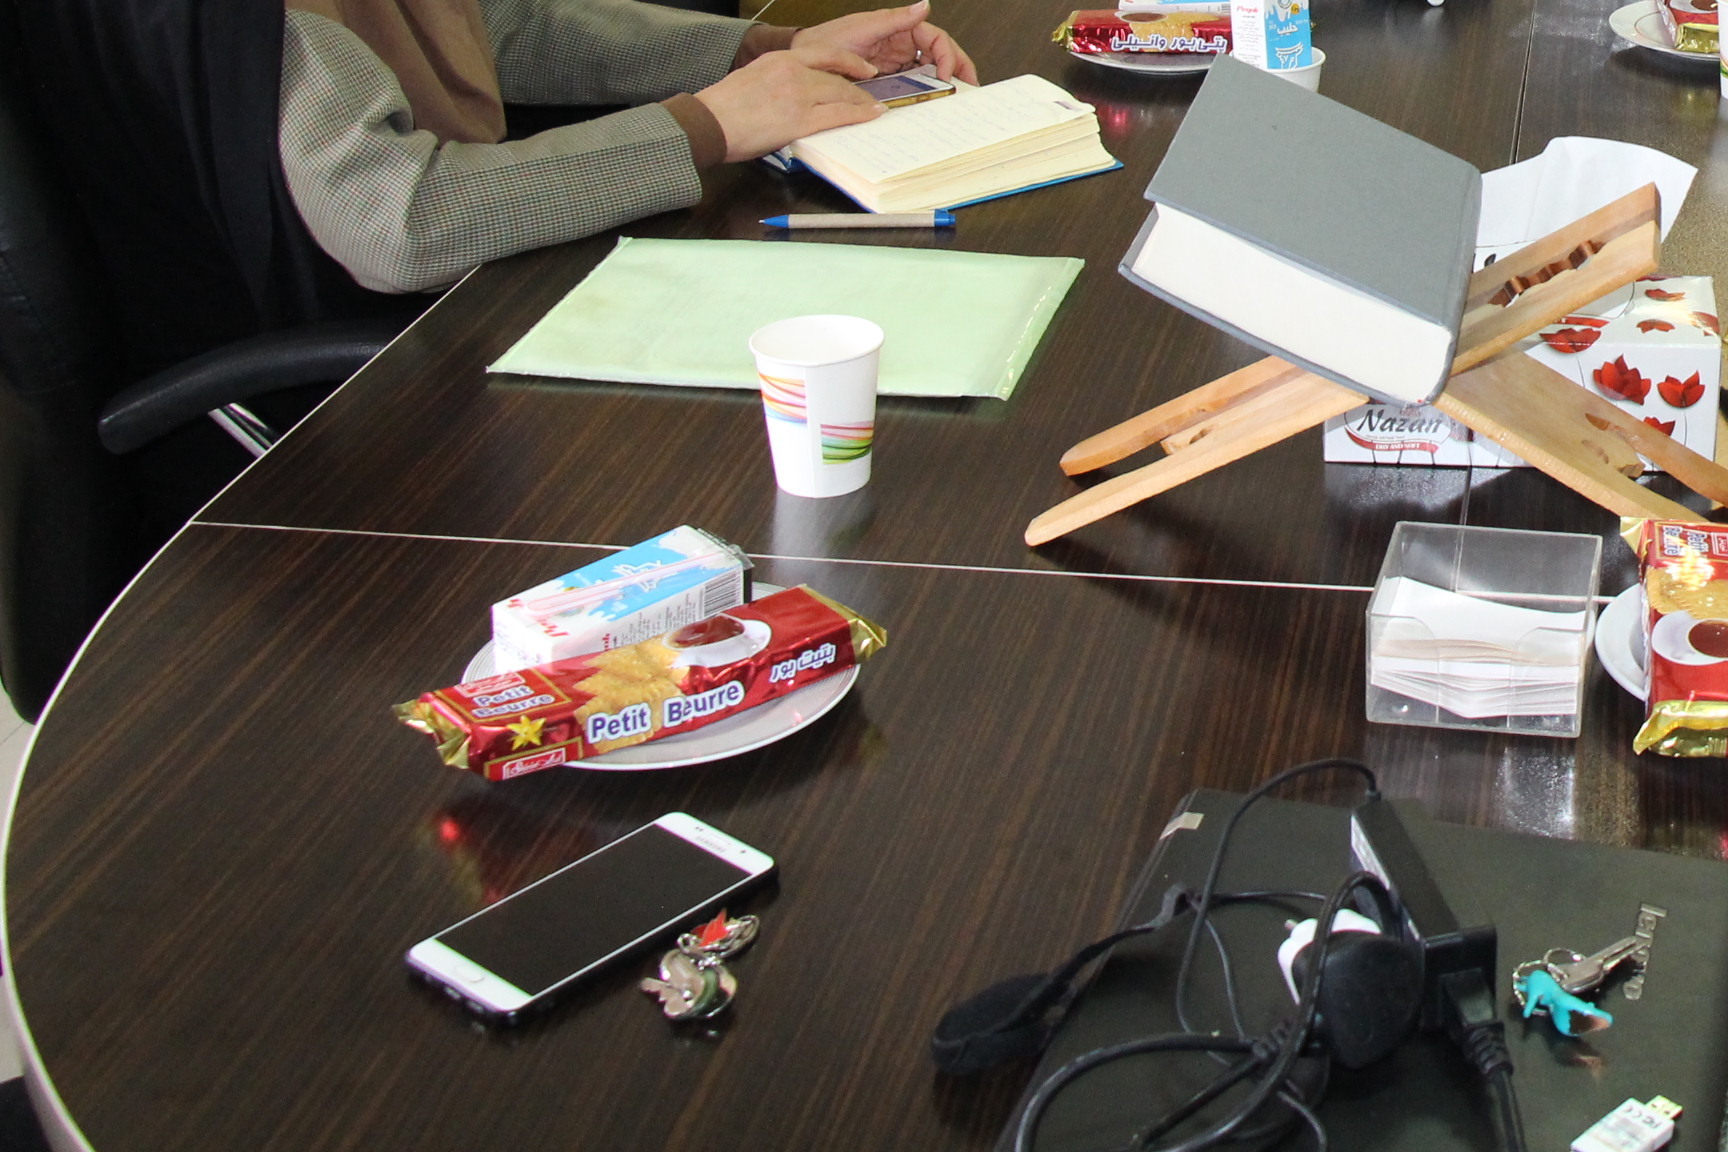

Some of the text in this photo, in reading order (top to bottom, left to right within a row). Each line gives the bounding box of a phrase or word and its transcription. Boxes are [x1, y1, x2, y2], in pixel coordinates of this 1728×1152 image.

[1111, 33, 1166, 51] وانیلی
[1357, 408, 1443, 434] Nazan
[472, 695, 556, 718] Beurre
[475, 685, 534, 708] Petit
[590, 681, 742, 740] Petit Beurre
